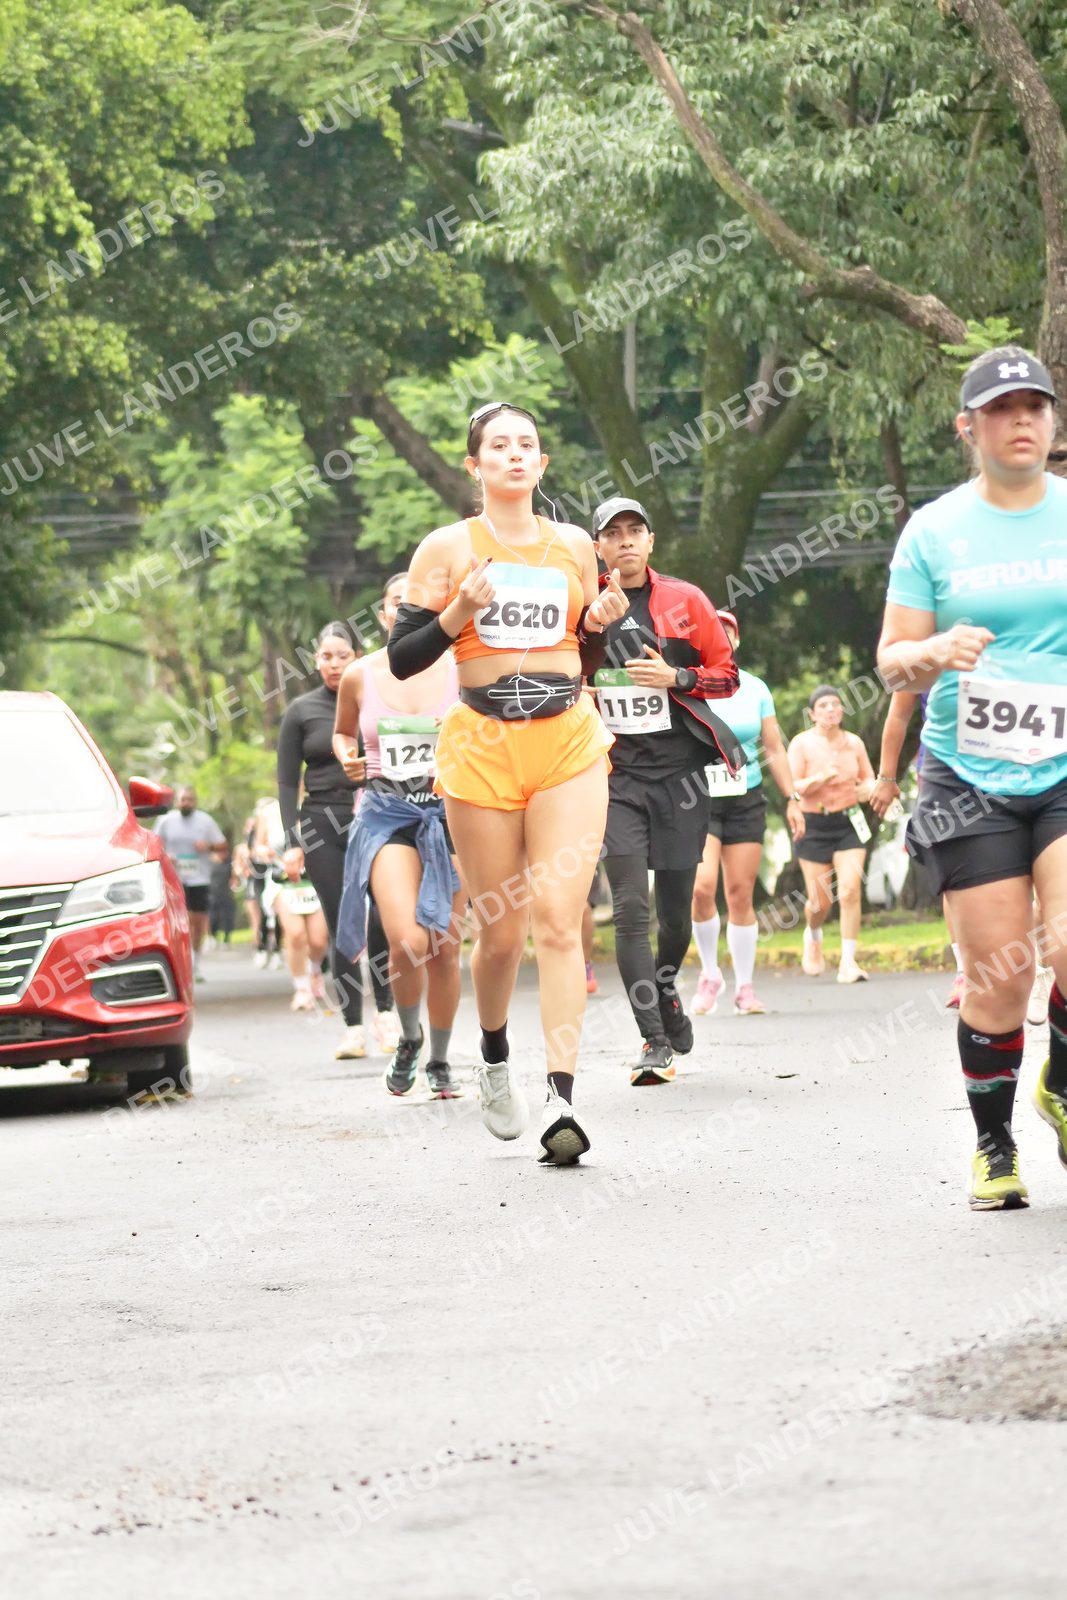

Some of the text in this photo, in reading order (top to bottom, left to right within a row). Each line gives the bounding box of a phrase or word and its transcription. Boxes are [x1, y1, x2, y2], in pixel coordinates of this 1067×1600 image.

[479, 601, 560, 629] 2620
[604, 695, 664, 718] 1159
[965, 697, 1066, 739] 3941
[386, 743, 436, 767] 122
[406, 792, 442, 803] NIK
